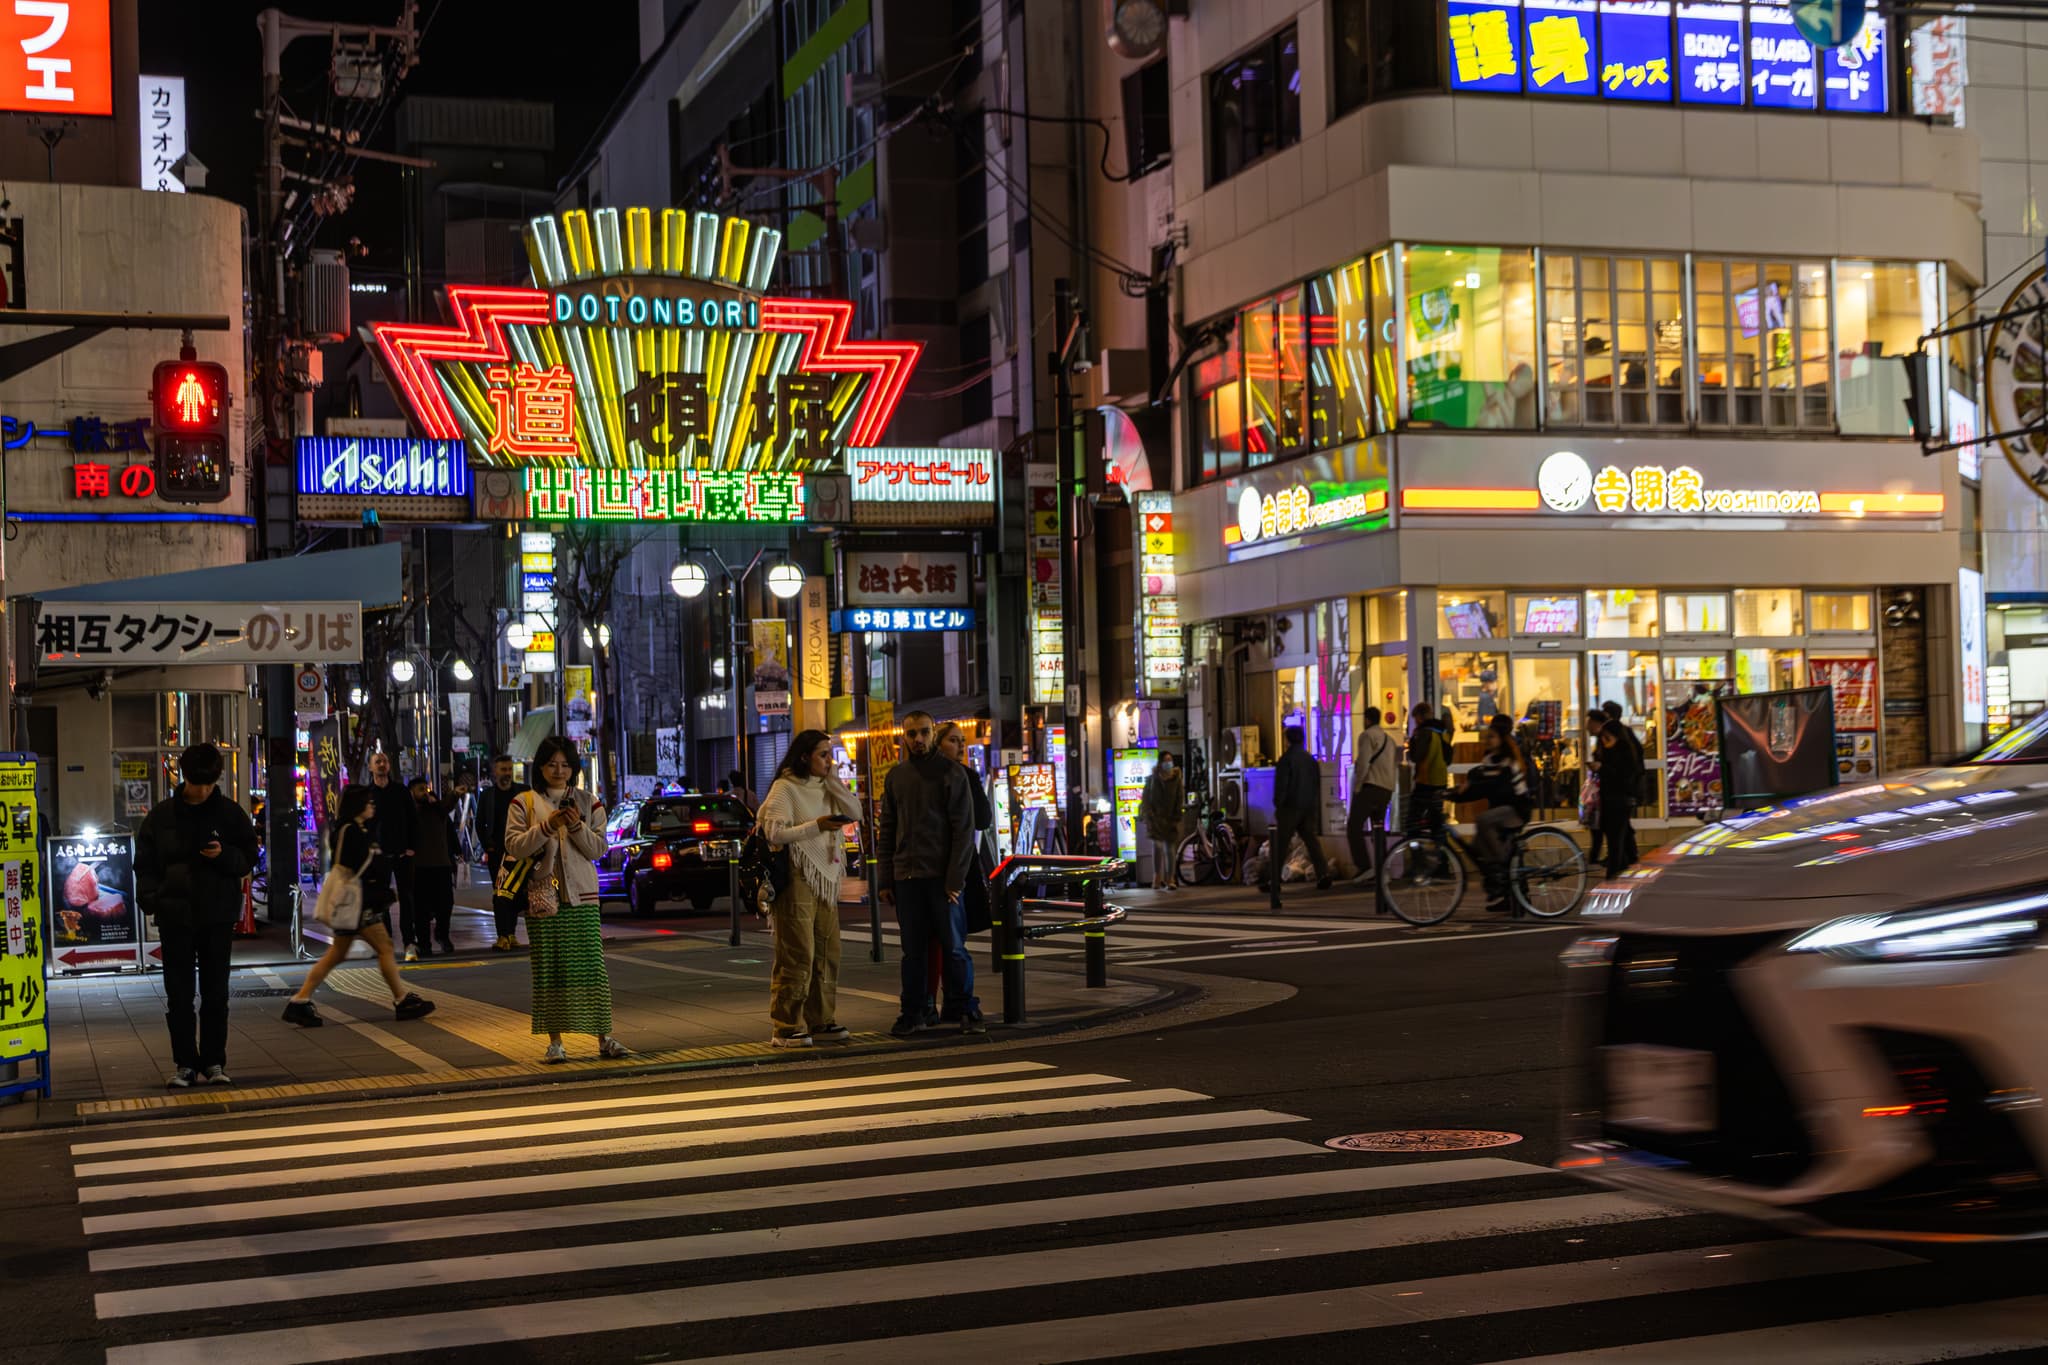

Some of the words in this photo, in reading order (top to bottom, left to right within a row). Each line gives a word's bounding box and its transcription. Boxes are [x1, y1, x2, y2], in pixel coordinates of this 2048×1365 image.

[555, 293, 758, 328] DOTONBORI
[487, 362, 836, 460] 道頓堀
[73, 461, 156, 498] 南の
[321, 440, 449, 490] Asahi
[1703, 490, 1820, 512] YOSHINOYA
[37, 613, 354, 654] 相互タクシーのりば
